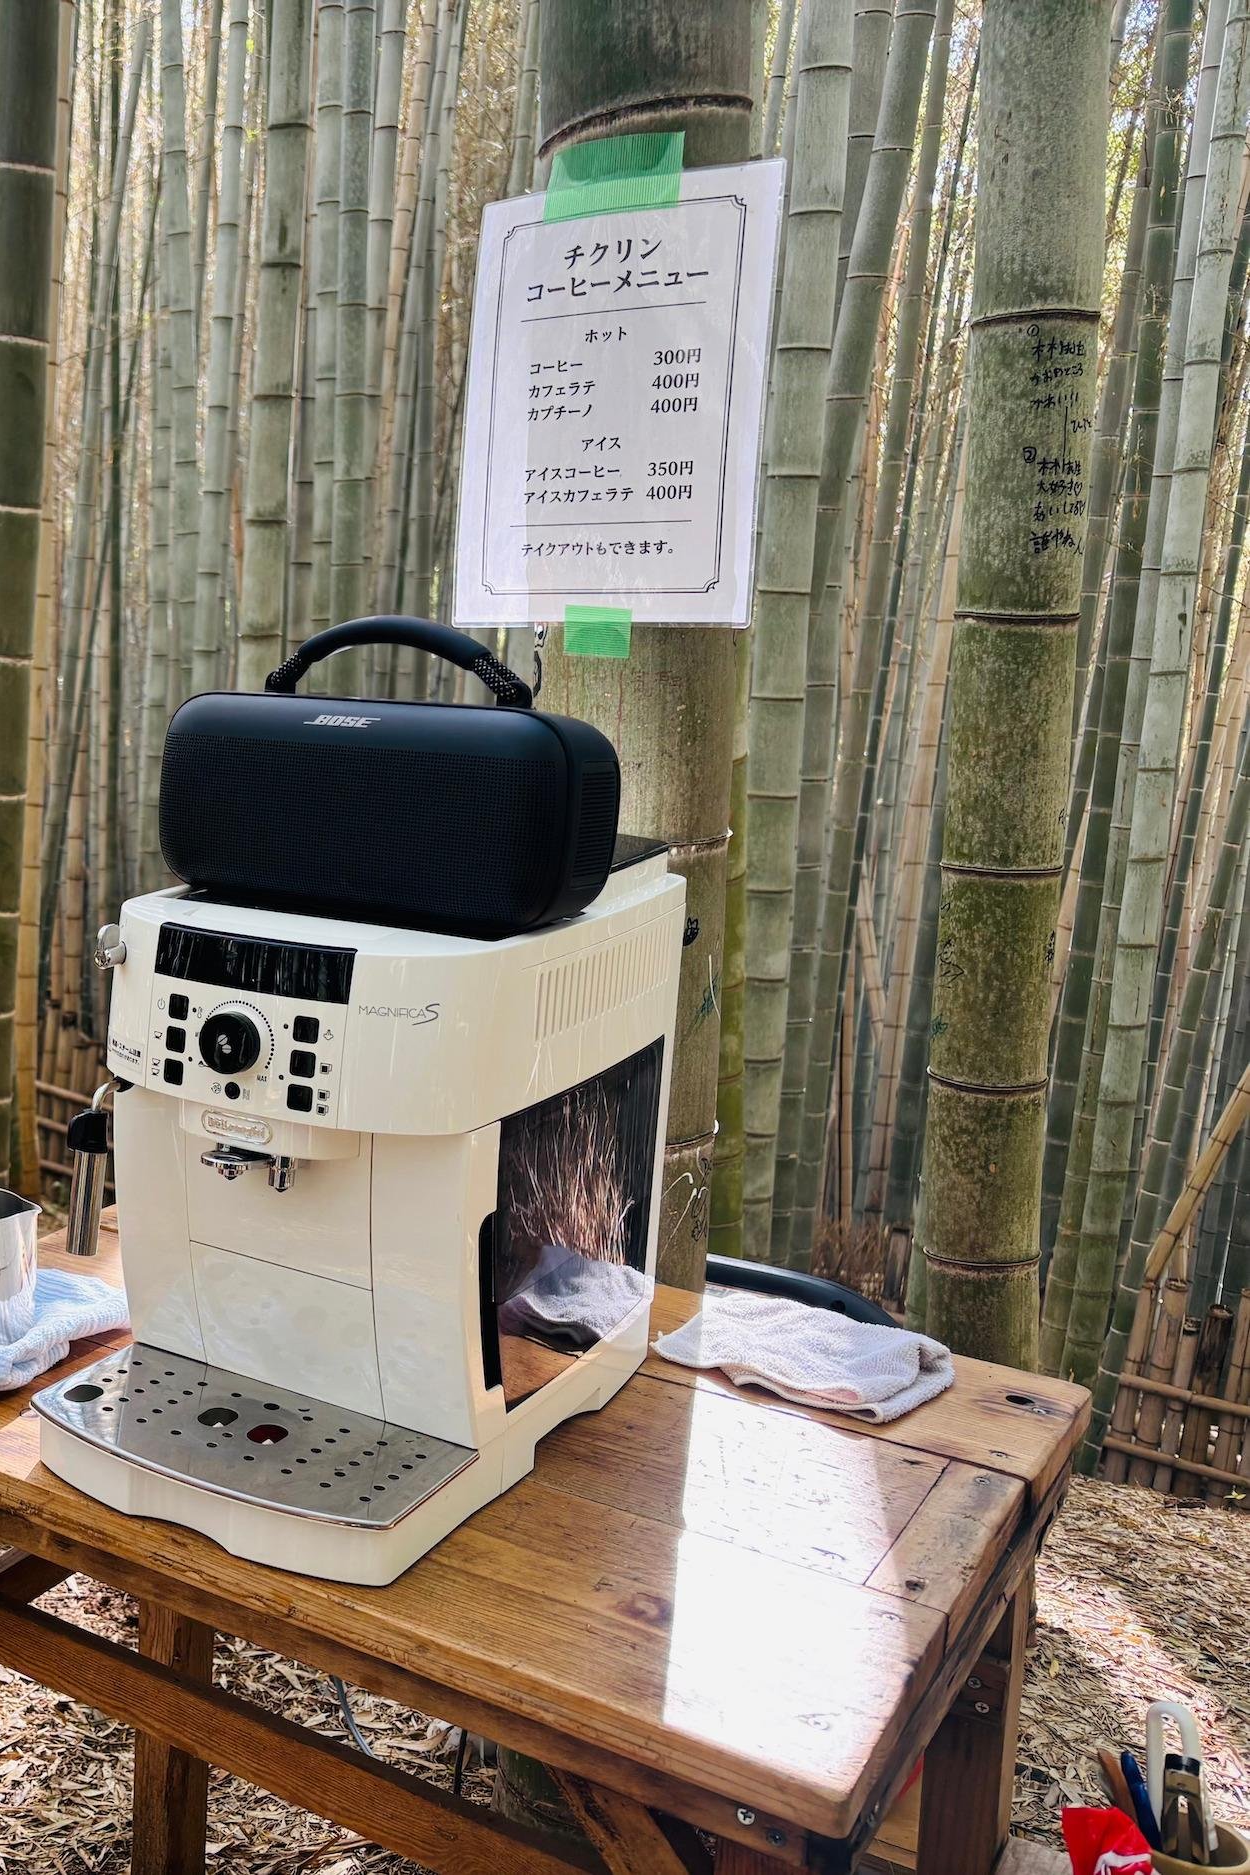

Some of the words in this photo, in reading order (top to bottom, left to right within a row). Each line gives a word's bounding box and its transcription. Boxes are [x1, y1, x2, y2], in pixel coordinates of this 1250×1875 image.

[564, 239, 662, 270] チクリン
[527, 269, 709, 301] コーヒーメニュー
[584, 326, 627, 344] ホット
[529, 359, 583, 375] コーヒー
[653, 347, 702, 366] 300円
[528, 380, 596, 400] カフェラテ
[651, 372, 700, 390] 400円
[526, 403, 593, 422] カプチーノ
[650, 396, 698, 414] 400円
[581, 436, 622, 452] アイス
[524, 464, 620, 482] アイスコーヒー
[647, 460, 694, 477] 350円
[523, 487, 634, 505] アイスカフェラテ
[645, 484, 693, 500] 400円
[521, 539, 674, 557] テイクアウトもできます。
[303, 714, 382, 729] BOSE
